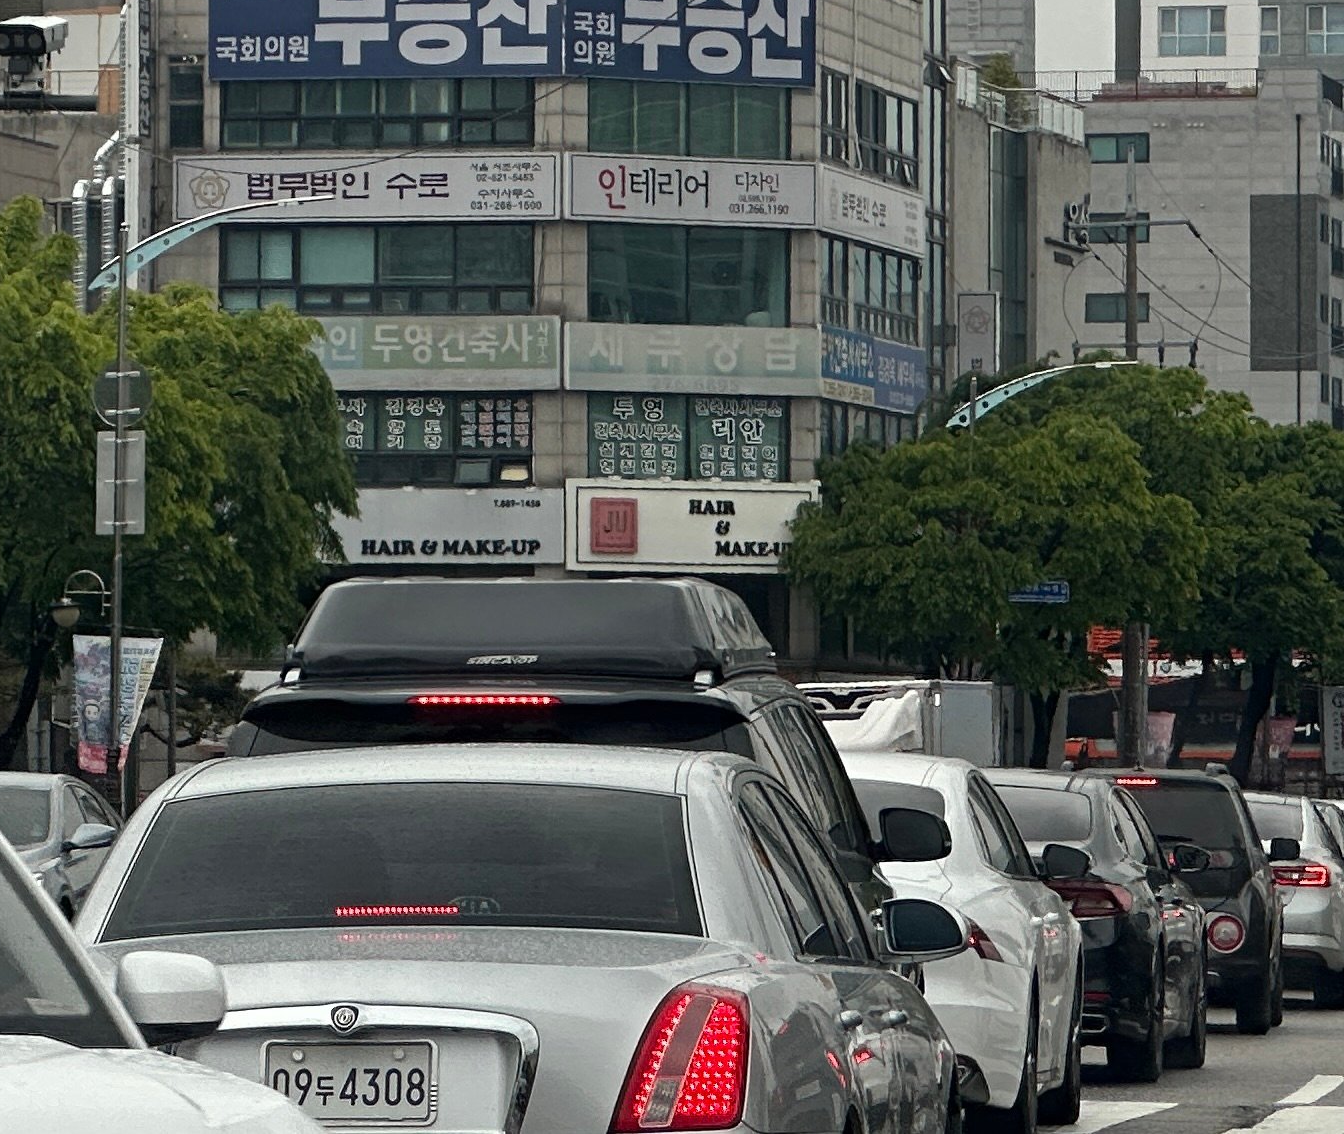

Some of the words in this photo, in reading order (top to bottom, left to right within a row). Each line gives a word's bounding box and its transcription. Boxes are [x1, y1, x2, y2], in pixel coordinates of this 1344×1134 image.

[573, 11, 615, 36] 국회
[215, 35, 309, 62] 국회의원
[573, 40, 615, 66] 의원
[247, 170, 369, 201] 법무법인
[386, 172, 450, 200] 수로
[598, 165, 709, 209] 인테리어
[735, 171, 779, 193] 디자인
[371, 323, 533, 364] 두영건축사
[613, 396, 664, 422] 두영
[712, 418, 765, 444] 리안
[689, 499, 736, 515] HAIR
[715, 520, 730, 535] &
[361, 540, 416, 556] HAIR
[420, 540, 438, 556] &
[442, 539, 541, 556] MAKE-UP
[273, 1068, 425, 1106] 09두4308
